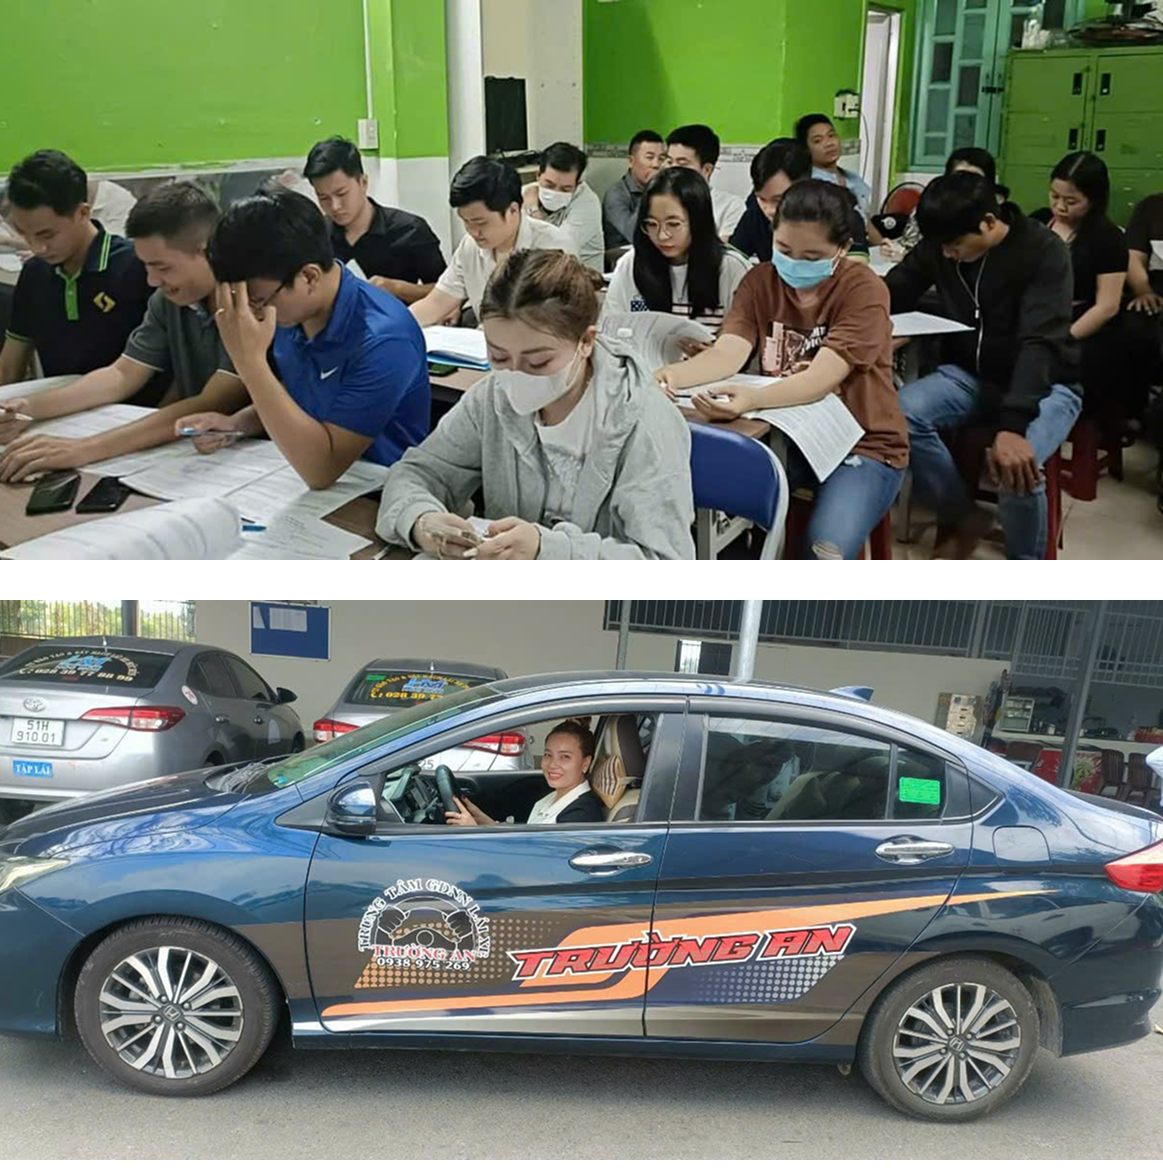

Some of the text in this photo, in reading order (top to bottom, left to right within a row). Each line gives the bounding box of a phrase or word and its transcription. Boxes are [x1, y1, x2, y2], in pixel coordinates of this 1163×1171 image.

[27, 720, 49, 731] 51H
[16, 762, 50, 777] TẬP LÁI
[358, 897, 387, 953] TRUNG
[384, 878, 424, 901] TÂM
[372, 941, 476, 964] TRƯỜNG AN
[508, 924, 856, 980] TRƯỜNG AN
[376, 957, 471, 971] 0938 975 269
